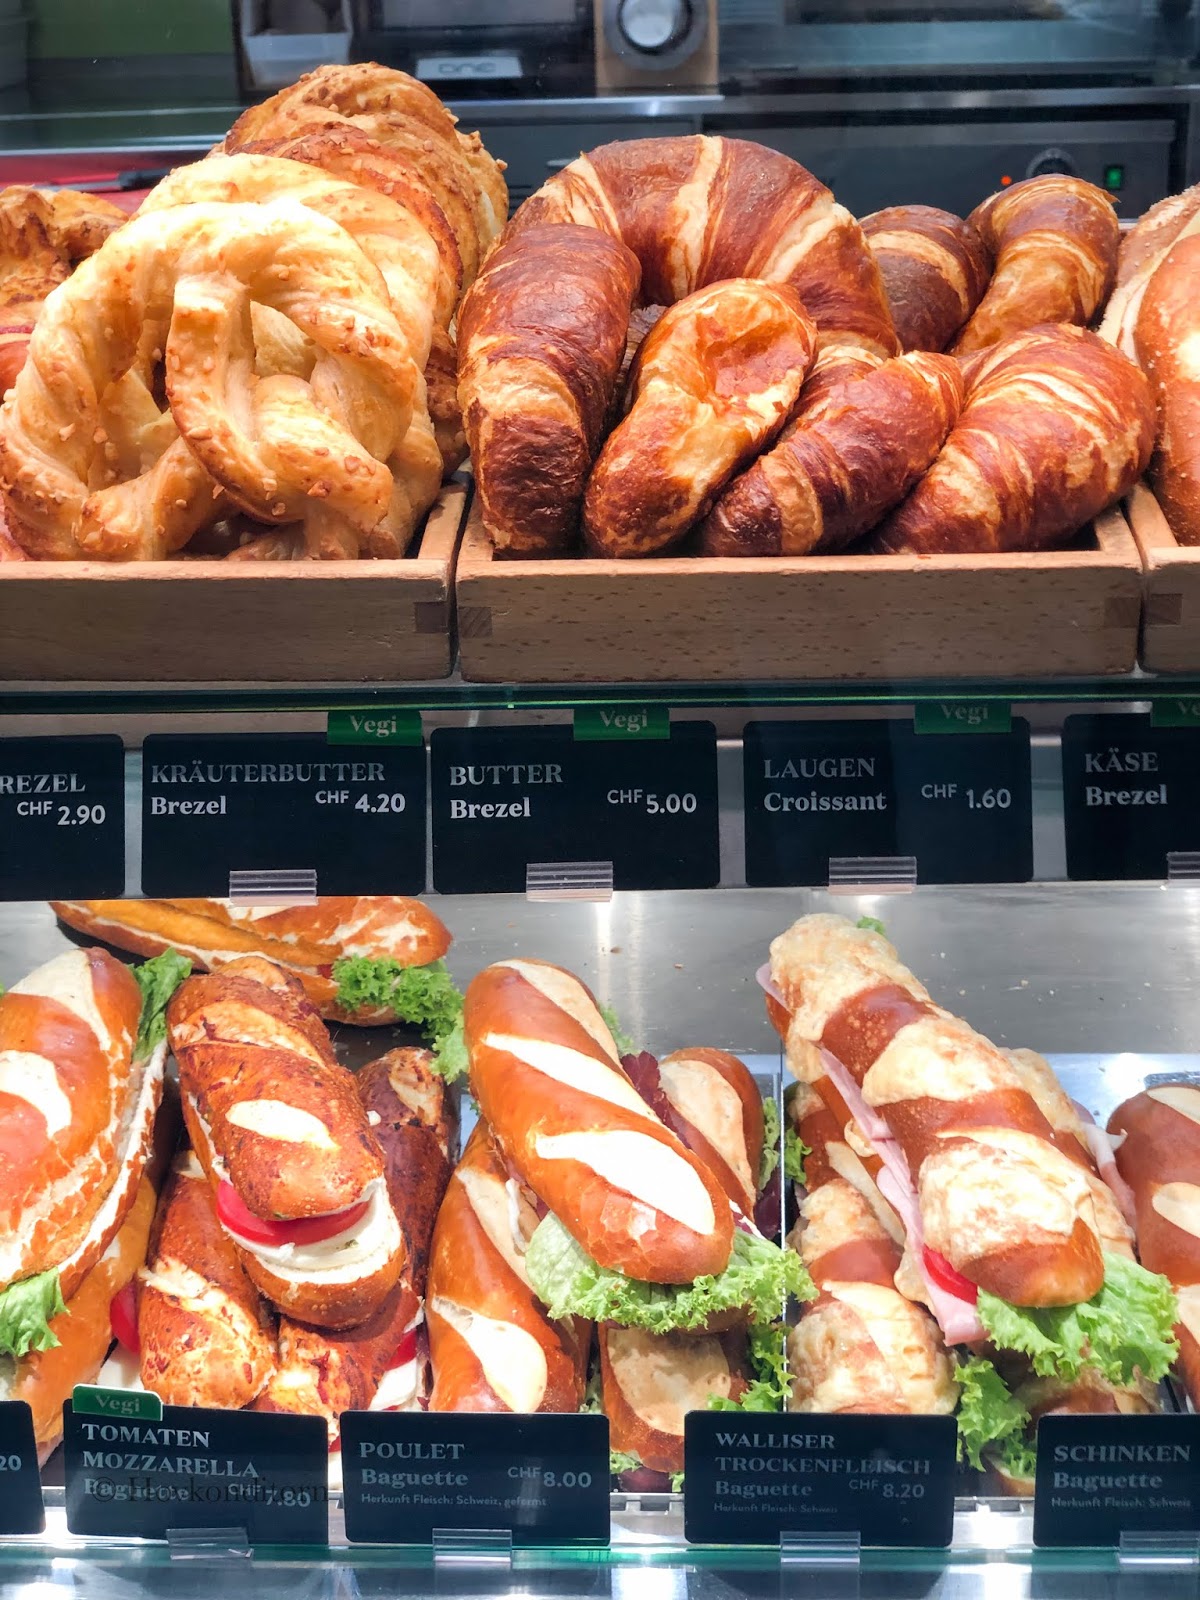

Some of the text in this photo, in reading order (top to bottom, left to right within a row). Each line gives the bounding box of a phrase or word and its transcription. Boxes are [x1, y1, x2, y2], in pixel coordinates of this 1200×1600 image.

[350, 715, 398, 738] Vegi
[600, 709, 649, 732] Vegi
[764, 757, 876, 779] LAUGEN
[1085, 747, 1159, 773] KÄSE
[151, 760, 386, 783] KRÄUTERBUTTER
[450, 764, 564, 786] BUTTER
[151, 796, 227, 815] Brezel
[315, 790, 406, 813] CHF 4.20
[606, 789, 698, 814] CHF 5.00
[763, 791, 887, 811] Croissant
[921, 784, 1012, 809] CHF 1.60
[1085, 783, 1168, 806] Brezel
[16, 801, 106, 826] CHF 2.90
[450, 797, 532, 819] Brezel
[95, 1394, 141, 1414] Vegi
[82, 1423, 211, 1448] TOMATEN
[715, 1433, 835, 1449] WALLISER
[359, 1442, 465, 1460] POULET
[1053, 1445, 1191, 1463] SCHINKEN
[83, 1451, 260, 1478] MOZZARELLA
[715, 1456, 930, 1475] TROCKENFLEISCH
[361, 1468, 469, 1489] Baguette
[507, 1466, 592, 1488] CHF 8.00
[1053, 1471, 1163, 1493] Baguette
[228, 1483, 312, 1508] CHF 7.80
[361, 1493, 410, 1504] Herkunft
[715, 1480, 813, 1499] Baguette
[848, 1479, 926, 1499] CHF 8.20
[713, 1503, 758, 1513] Herkunft
